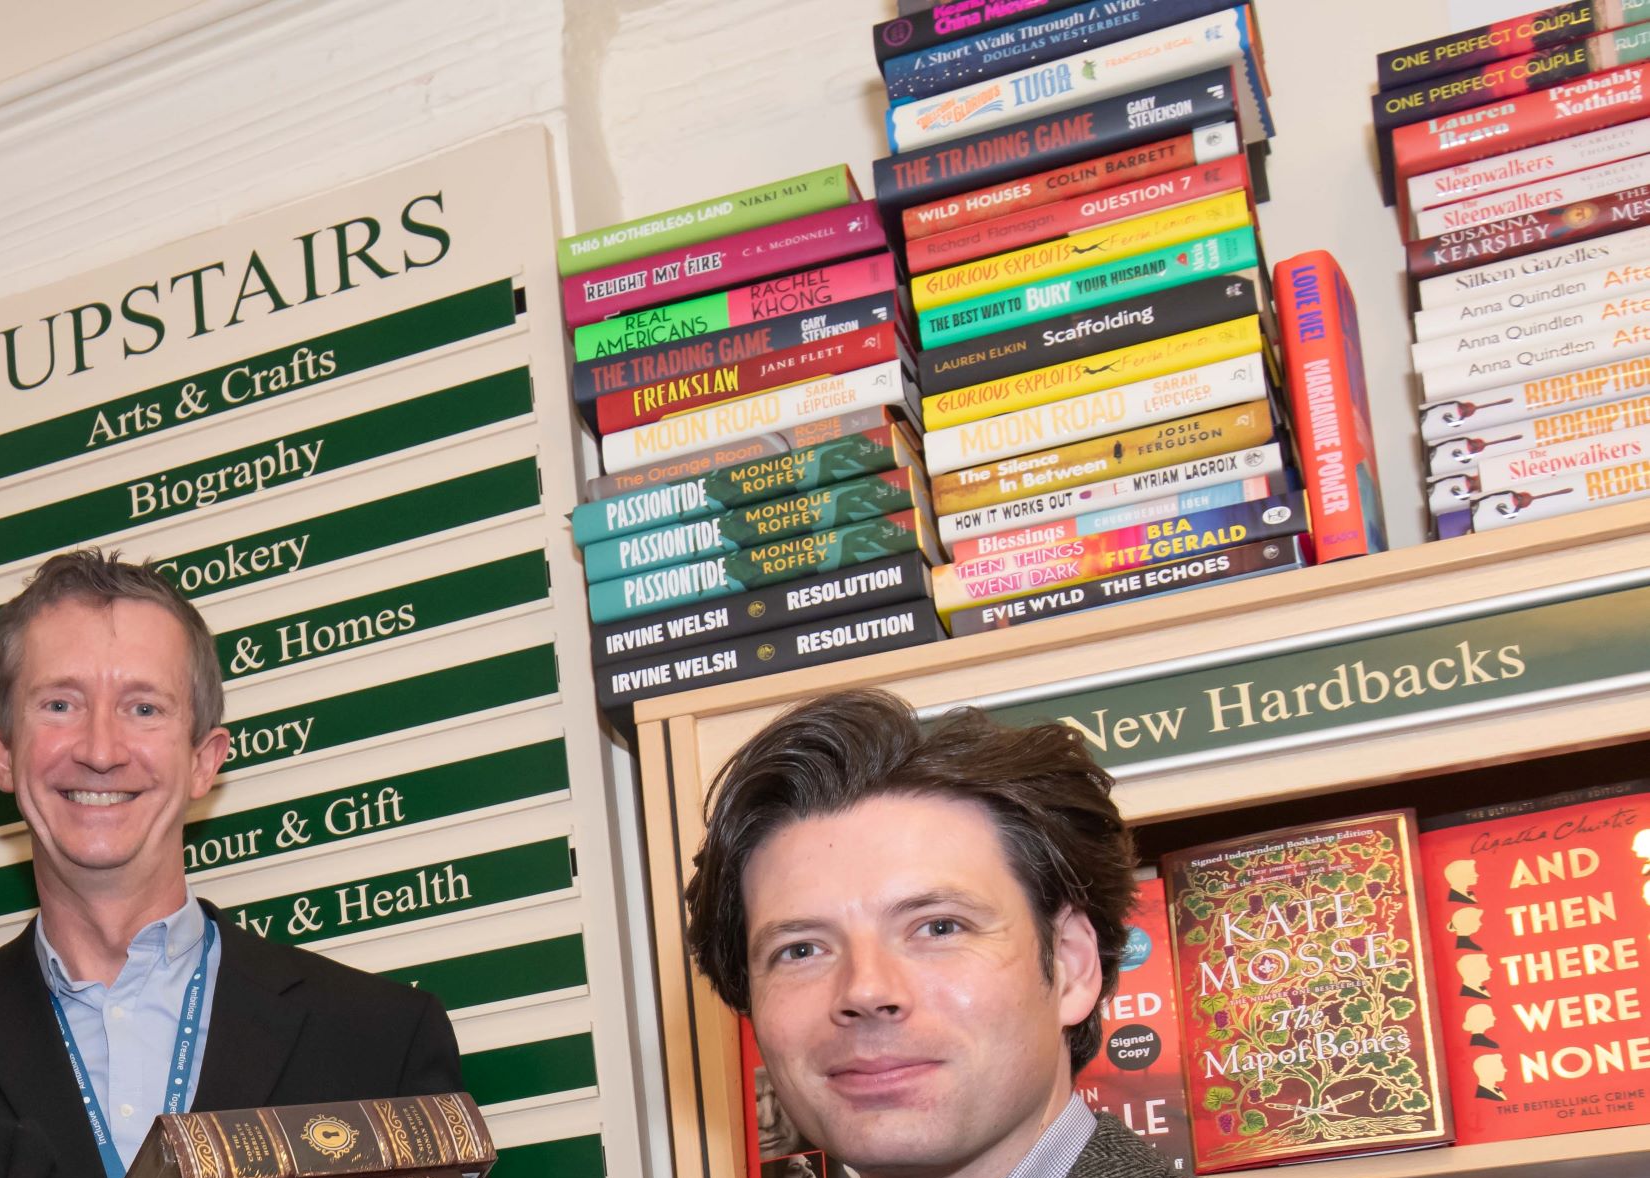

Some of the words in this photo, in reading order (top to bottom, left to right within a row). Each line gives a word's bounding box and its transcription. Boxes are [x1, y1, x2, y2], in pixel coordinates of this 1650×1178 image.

[983, 40, 1046, 63] DOUGLAS
[1050, 11, 1140, 44] WESTERBEKE
[1391, 50, 1430, 72] ONE
[1435, 28, 1511, 60] PERFECT
[1516, 7, 1592, 40] COUPLE
[1386, 93, 1425, 113] ONE
[1429, 70, 1506, 101] PERFECT
[1510, 48, 1585, 80] COUPLE
[1127, 97, 1155, 116] GARY
[1128, 100, 1192, 129] STEVENSON
[893, 162, 933, 190] THE
[936, 136, 1029, 179] TRADING
[1035, 113, 1098, 153] GAME
[918, 202, 959, 223] WILD
[966, 183, 1032, 212] HOUSES
[1046, 164, 1098, 190] COLIN
[1105, 145, 1177, 173] BARRETT
[1080, 182, 1175, 217] QUESTION
[1179, 177, 1191, 191] 7
[583, 271, 647, 302] RELIGHT
[653, 263, 679, 284] MY
[686, 253, 721, 276] FIRE
[1043, 306, 1154, 346] Scaffolding
[86, 400, 162, 448] Arts
[173, 384, 209, 418] &
[220, 346, 337, 403] Crafts
[1157, 420, 1201, 439] JOSIE
[128, 439, 325, 519] Biography
[731, 451, 816, 482] MONIQUE
[606, 479, 708, 531] PASSIONTIDE
[746, 492, 832, 523] MONIQUE
[956, 512, 982, 530] HOW
[987, 508, 999, 524] IT
[1003, 499, 1045, 520] WORKS
[1049, 492, 1073, 510] OUT
[620, 518, 722, 569] PASSIONTIDE
[750, 532, 837, 562] MONIQUE
[1104, 525, 1247, 568] FITZGERALD
[1147, 520, 1193, 540] BEA
[624, 557, 727, 608] PASSIONTIDE
[982, 600, 1026, 623] EVIE
[1028, 589, 1085, 614] WYLD
[1101, 575, 1141, 596] THE
[1145, 556, 1230, 587] ECHOES
[606, 625, 663, 654] IRVINE
[667, 608, 729, 639] WELSH
[786, 566, 902, 611] RESOLUTION
[229, 636, 264, 673] &
[277, 603, 416, 662] Homes
[612, 667, 671, 693] IRVINE
[675, 650, 737, 681] WELSH
[796, 612, 914, 654] RESOLUTION
[1059, 707, 1187, 754] New
[1204, 640, 1527, 735] Hardbacks
[227, 718, 314, 760] story
[275, 810, 311, 848] &
[324, 787, 405, 835] Gift
[1191, 854, 1222, 868] Signed
[1224, 842, 1285, 863] Independent
[1287, 834, 1334, 853] Bookshop
[1336, 827, 1374, 842] Edition
[1509, 847, 1601, 890] AND
[287, 898, 323, 935] &
[335, 864, 472, 925] Health
[1221, 892, 1364, 947] KATE
[1505, 891, 1618, 937] THEN
[1198, 931, 1397, 998] MOSSE
[1501, 937, 1639, 986] THERE
[187, 986, 199, 1020] Ambitious
[1272, 1007, 1324, 1033] The
[1512, 988, 1642, 1033] WERE
[177, 1041, 190, 1071] Creative
[1109, 1031, 1155, 1050] Signed
[1117, 1043, 1151, 1060] Copy
[1204, 1046, 1271, 1080] Map
[1272, 1038, 1307, 1067] of
[1315, 1026, 1410, 1060] Bones
[1518, 1037, 1650, 1083] NONE
[1496, 1104, 1519, 1114] THE
[1523, 1095, 1600, 1112] BESTSELLING
[1604, 1089, 1646, 1102] CRIME
[1557, 1110, 1574, 1119] OF
[1578, 1107, 1601, 1117] ALL
[1605, 1101, 1635, 1113] TIME
[89, 1110, 106, 1145] Inclusive
